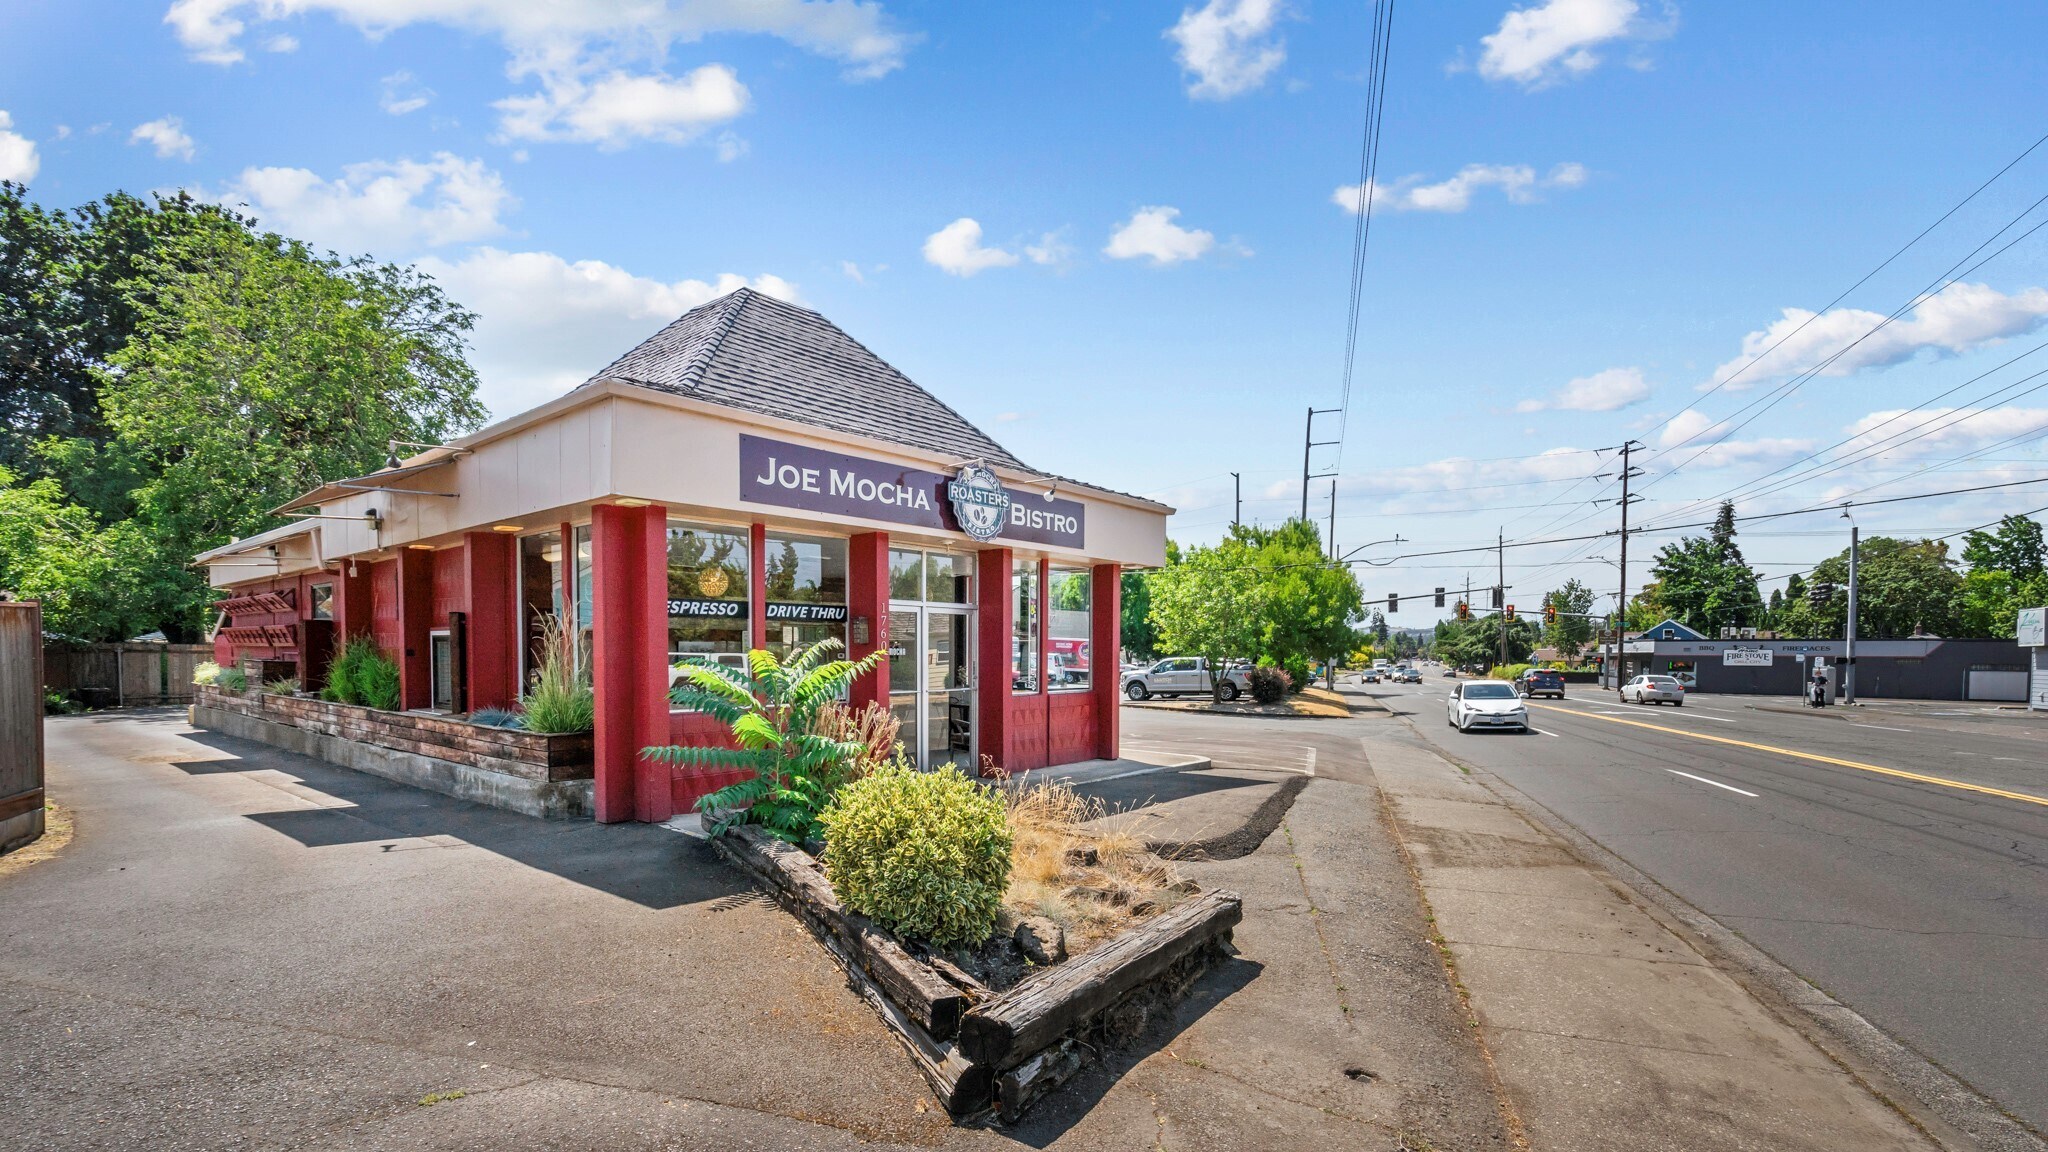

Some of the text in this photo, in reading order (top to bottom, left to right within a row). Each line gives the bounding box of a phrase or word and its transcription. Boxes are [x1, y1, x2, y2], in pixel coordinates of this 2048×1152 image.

[756, 457, 931, 511] JOE MOCHA
[950, 485, 1009, 507] ROASTERS
[1011, 503, 1078, 534] BISTRO
[967, 523, 995, 534] BISTRO
[766, 604, 845, 620] DRIVE THRU
[1726, 653, 1770, 661] FIRE STOVE
